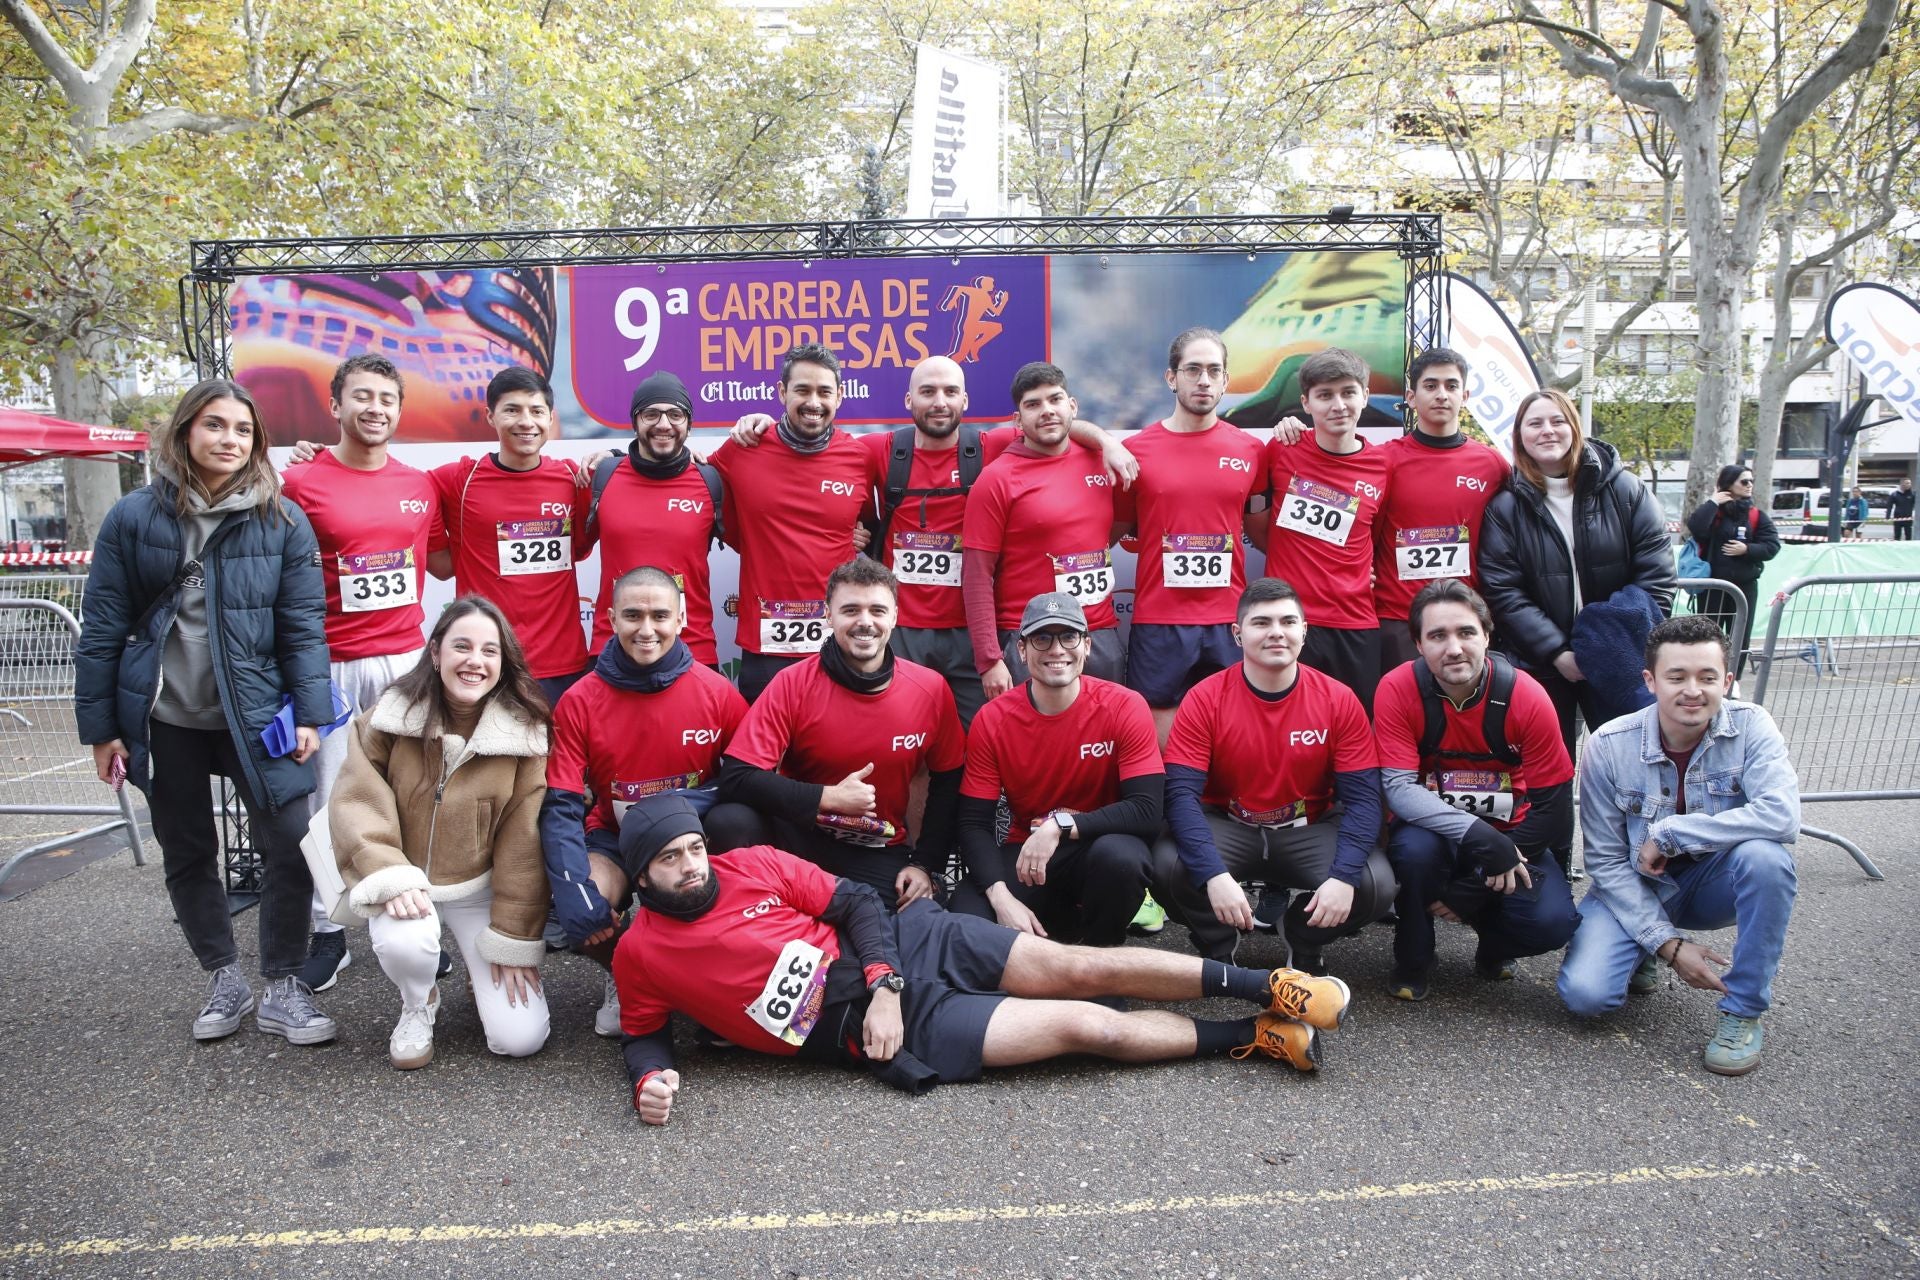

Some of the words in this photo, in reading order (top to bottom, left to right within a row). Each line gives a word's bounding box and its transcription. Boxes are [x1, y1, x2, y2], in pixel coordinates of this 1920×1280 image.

[699, 279, 871, 322] CARRERA
[882, 278, 930, 318] DE
[700, 379, 722, 402] El
[726, 380, 774, 401] Norte
[1290, 499, 1342, 532] 330
[510, 540, 562, 564] 328
[902, 552, 951, 575] 329
[1407, 546, 1458, 569] 327
[1173, 555, 1222, 577] 336
[352, 572, 407, 600] 333
[1066, 570, 1108, 597] 335
[770, 621, 823, 643] 326
[640, 785, 672, 795] EMPRESAS
[1454, 777, 1486, 785] EMPRESAS
[766, 955, 813, 1021] 339
